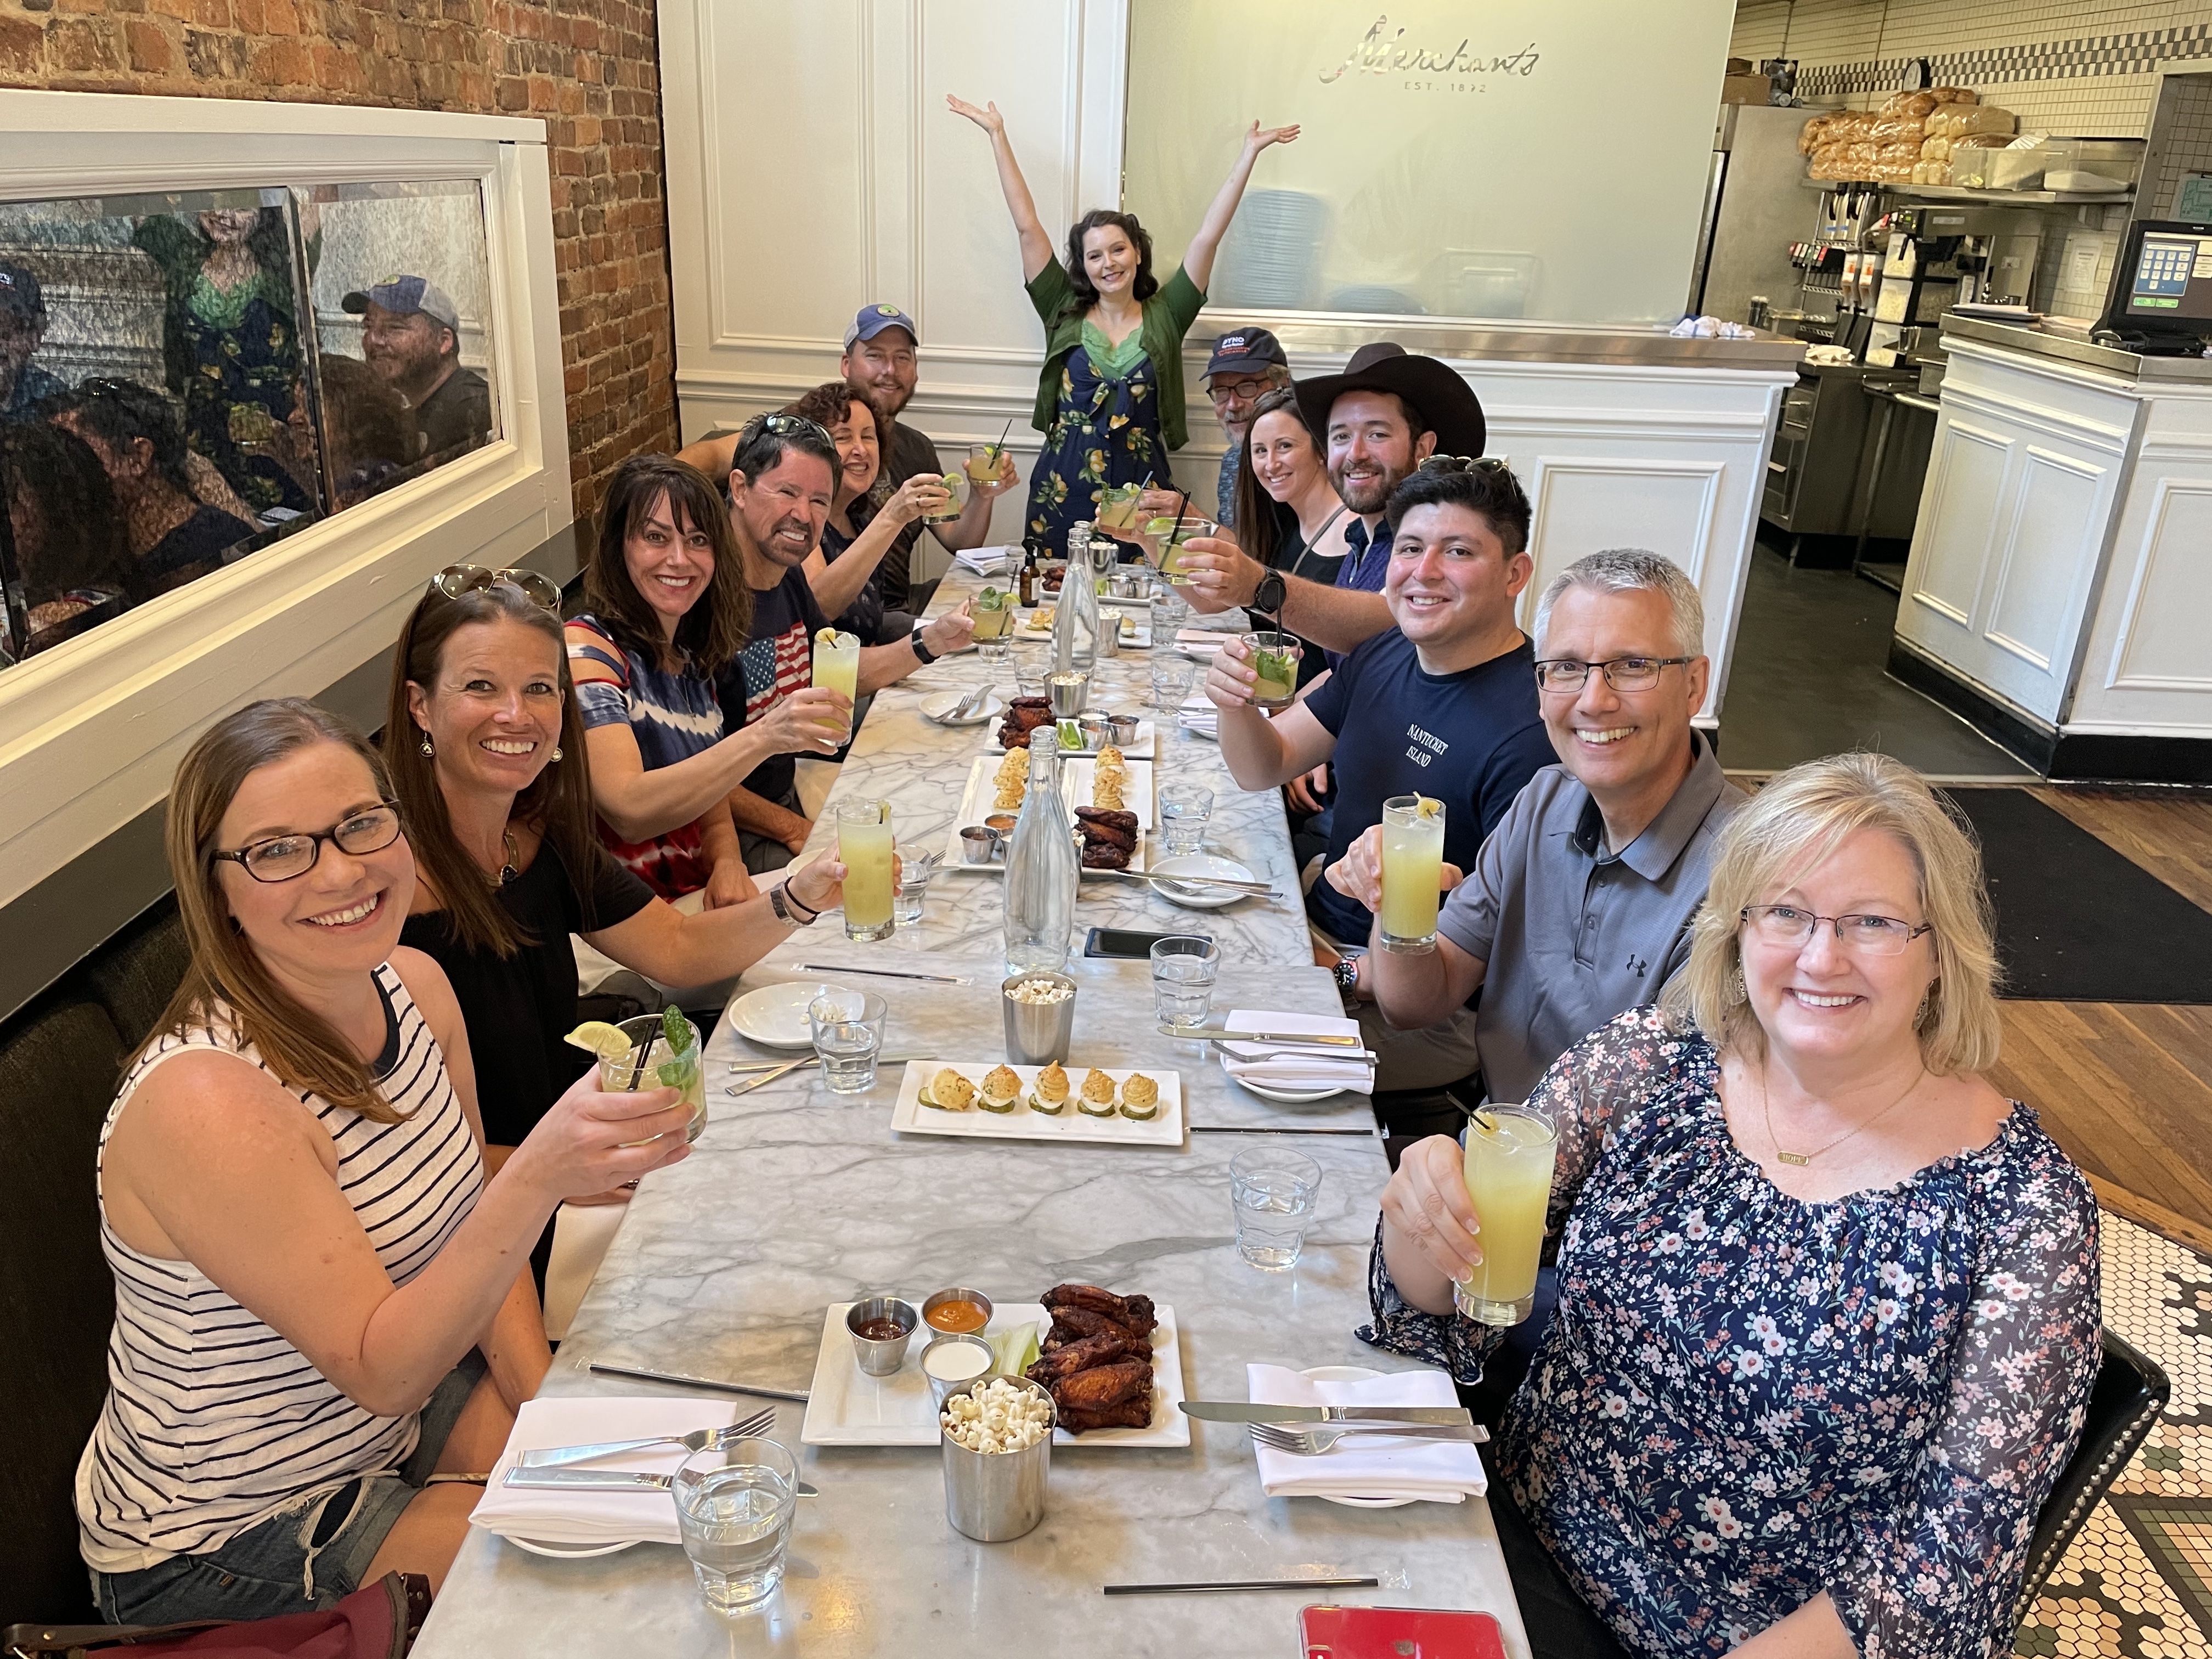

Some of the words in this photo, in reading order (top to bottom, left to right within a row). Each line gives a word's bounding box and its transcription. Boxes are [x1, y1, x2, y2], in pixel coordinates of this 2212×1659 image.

[1404, 81, 1439, 91] EST.
[1407, 724, 1449, 755] NANTUCKET
[1406, 745, 1431, 768] ISLAND
